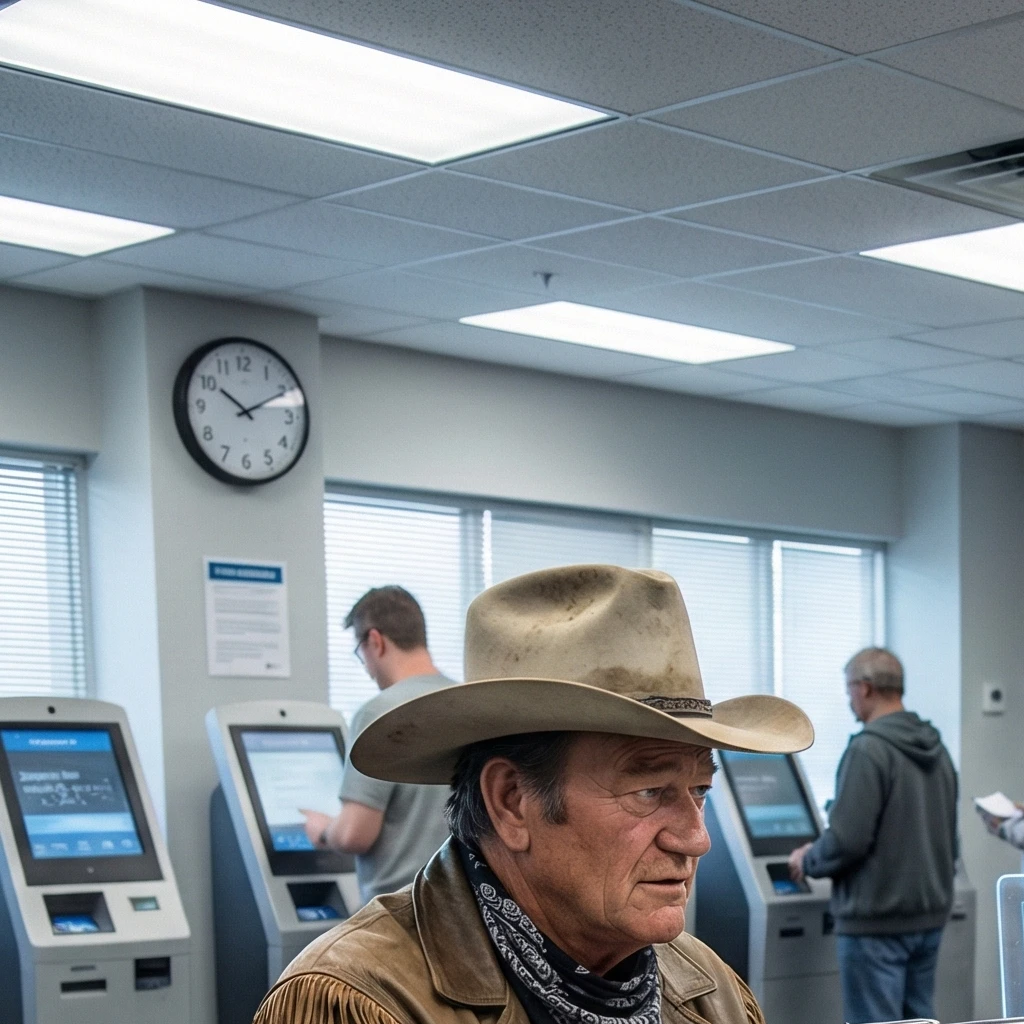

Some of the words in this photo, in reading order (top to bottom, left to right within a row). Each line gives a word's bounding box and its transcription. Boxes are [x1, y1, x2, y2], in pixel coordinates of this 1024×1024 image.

[217, 359, 229, 375] 11
[236, 356, 251, 372] 12
[264, 365, 269, 381] 1
[201, 374, 217, 391] 10
[196, 398, 206, 414] 9
[284, 409, 294, 425] 3
[203, 426, 213, 441] 8
[277, 435, 288, 449] 4
[221, 444, 230, 462] 7
[264, 449, 273, 466] 5
[241, 454, 251, 470] 6
